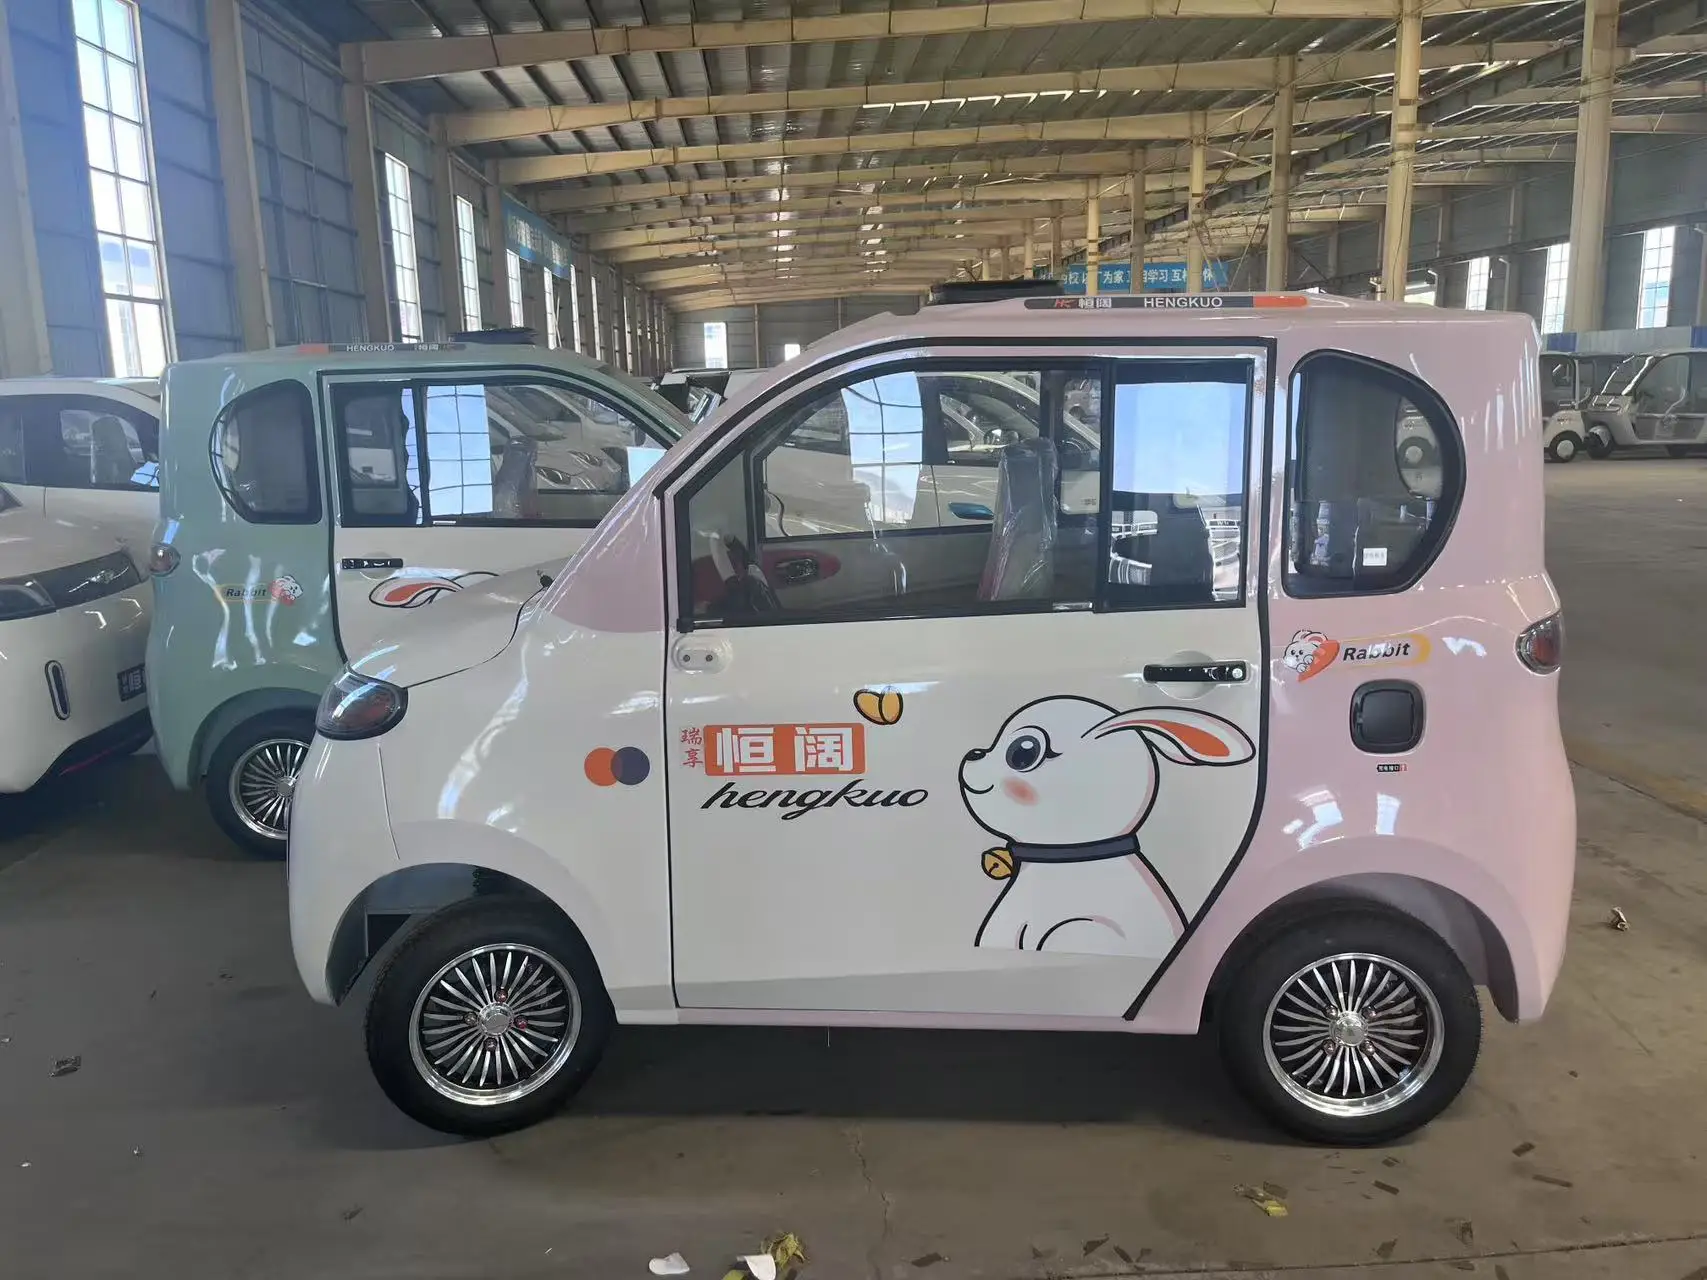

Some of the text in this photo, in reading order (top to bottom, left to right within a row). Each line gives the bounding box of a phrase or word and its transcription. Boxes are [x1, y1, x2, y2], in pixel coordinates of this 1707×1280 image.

[1144, 297, 1223, 308] HENGKUO
[346, 344, 395, 352] HENGKUO
[1343, 642, 1411, 661] Rabbit
[716, 726, 854, 773] 恒阔
[701, 778, 929, 821] hengkuo
